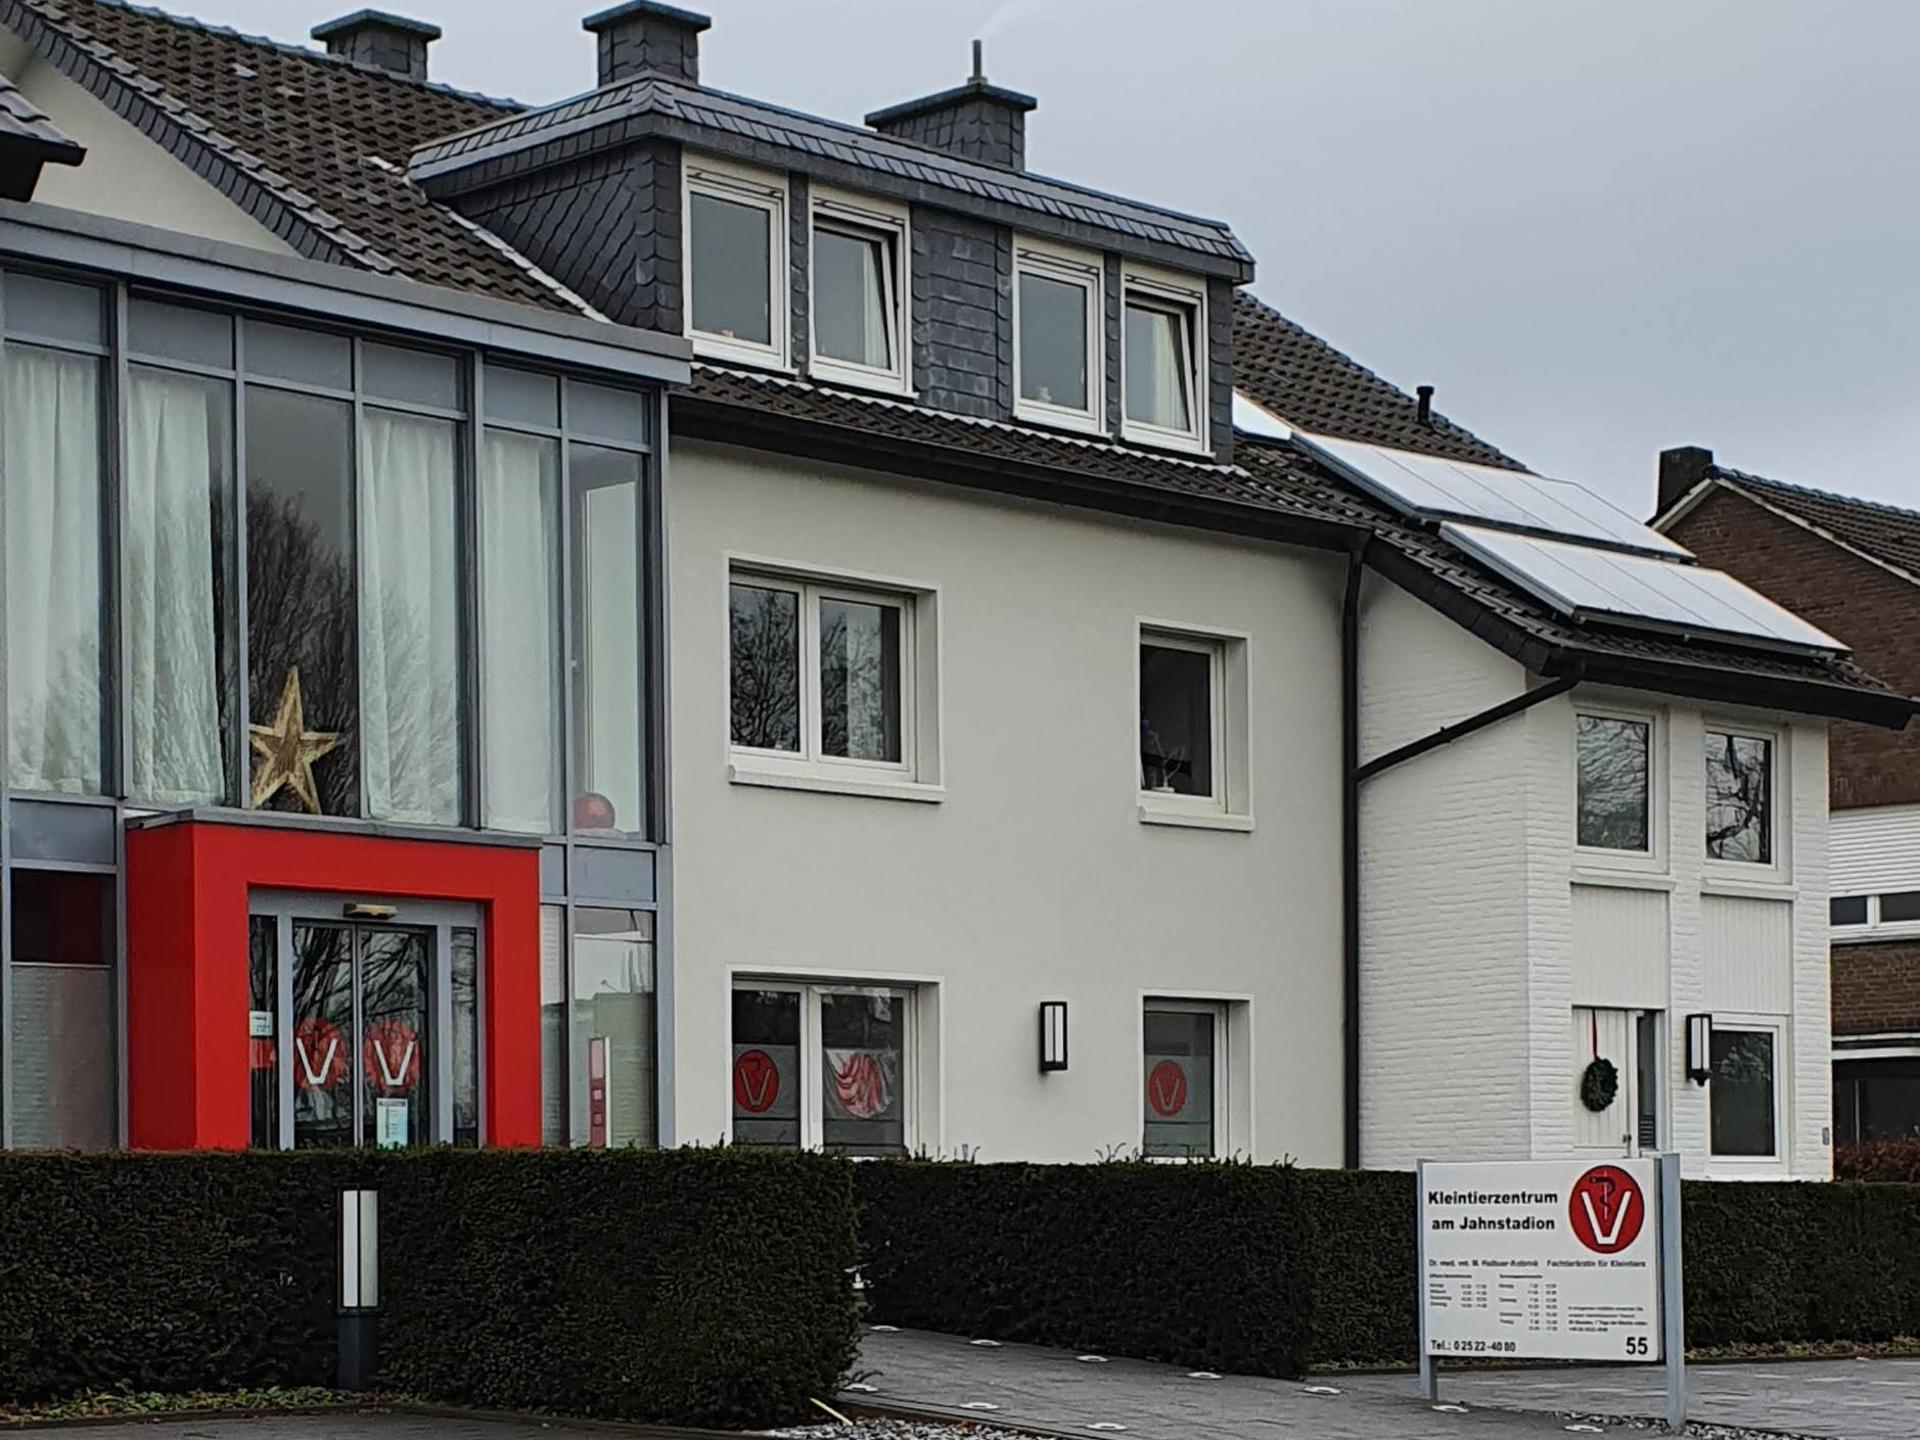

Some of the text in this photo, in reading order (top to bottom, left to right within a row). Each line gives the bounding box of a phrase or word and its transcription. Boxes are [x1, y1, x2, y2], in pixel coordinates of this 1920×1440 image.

[1428, 1191, 1558, 1205] Kleintierzentrum
[1431, 1216, 1556, 1230] am Jahnstadion
[1626, 1336, 1649, 1355] 55
